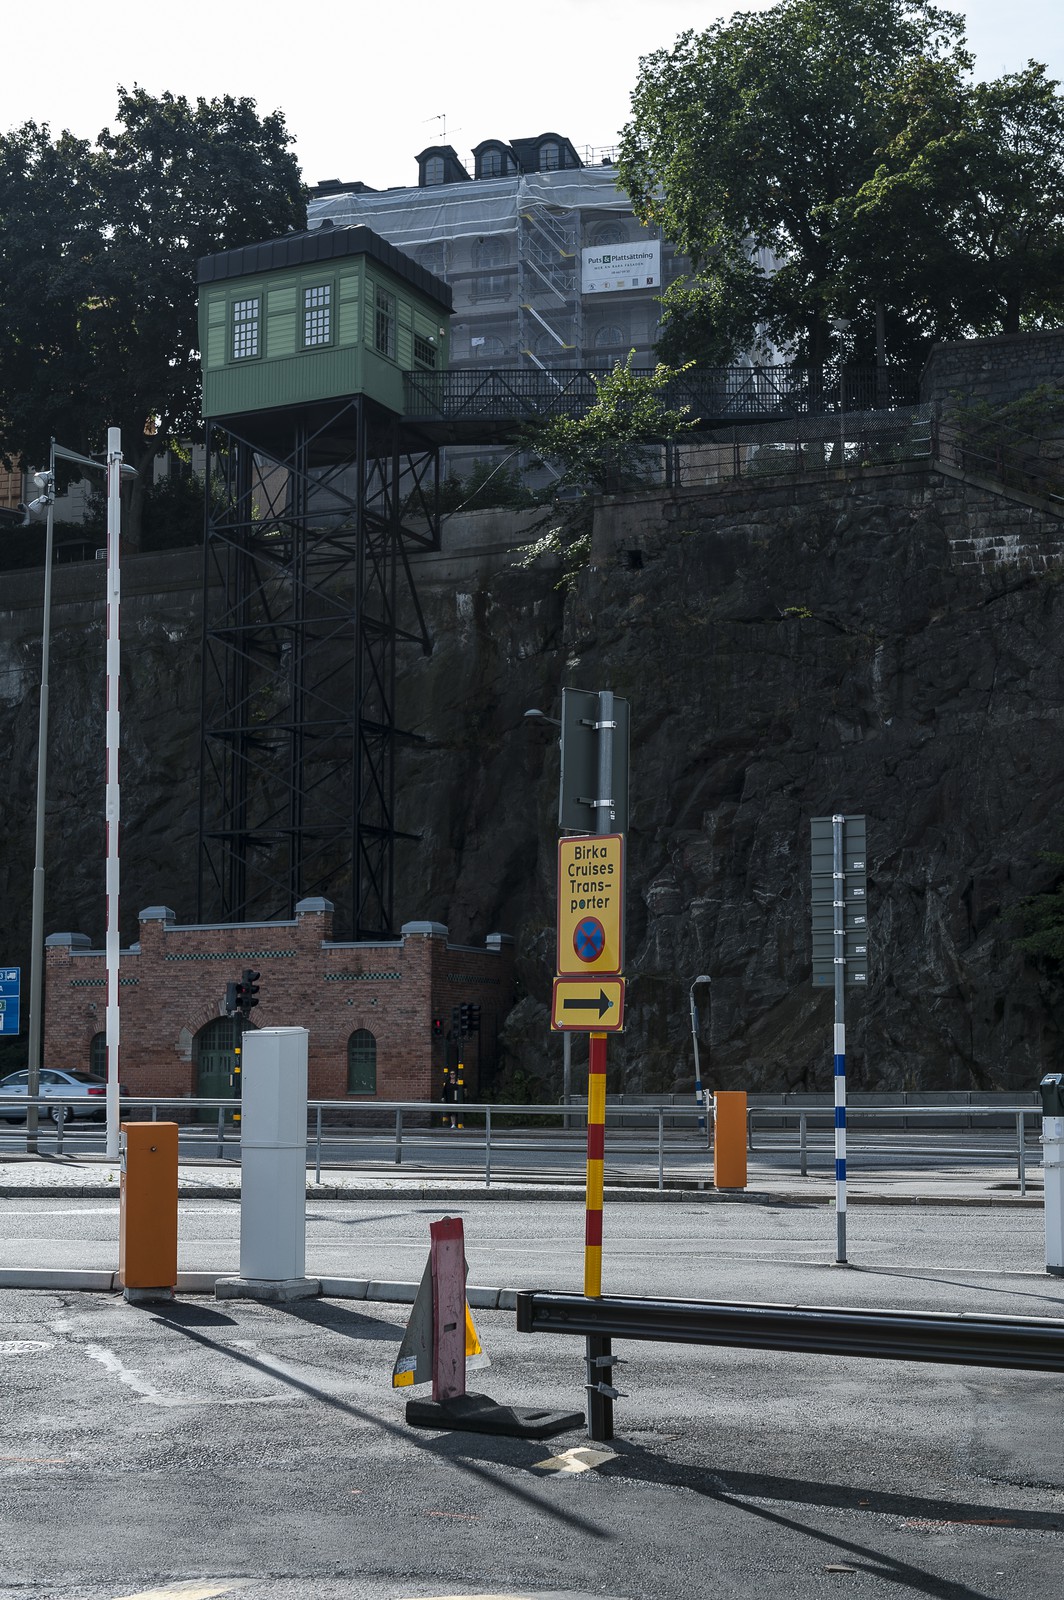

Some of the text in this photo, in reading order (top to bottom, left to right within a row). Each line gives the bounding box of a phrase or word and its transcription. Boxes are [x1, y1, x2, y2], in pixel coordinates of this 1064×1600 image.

[603, 255, 611, 263] &
[612, 252, 654, 261] Plattsättning
[574, 845, 607, 860] Birka
[568, 862, 614, 877] Cruises
[570, 879, 612, 893] Trans-
[570, 896, 610, 913] porter
